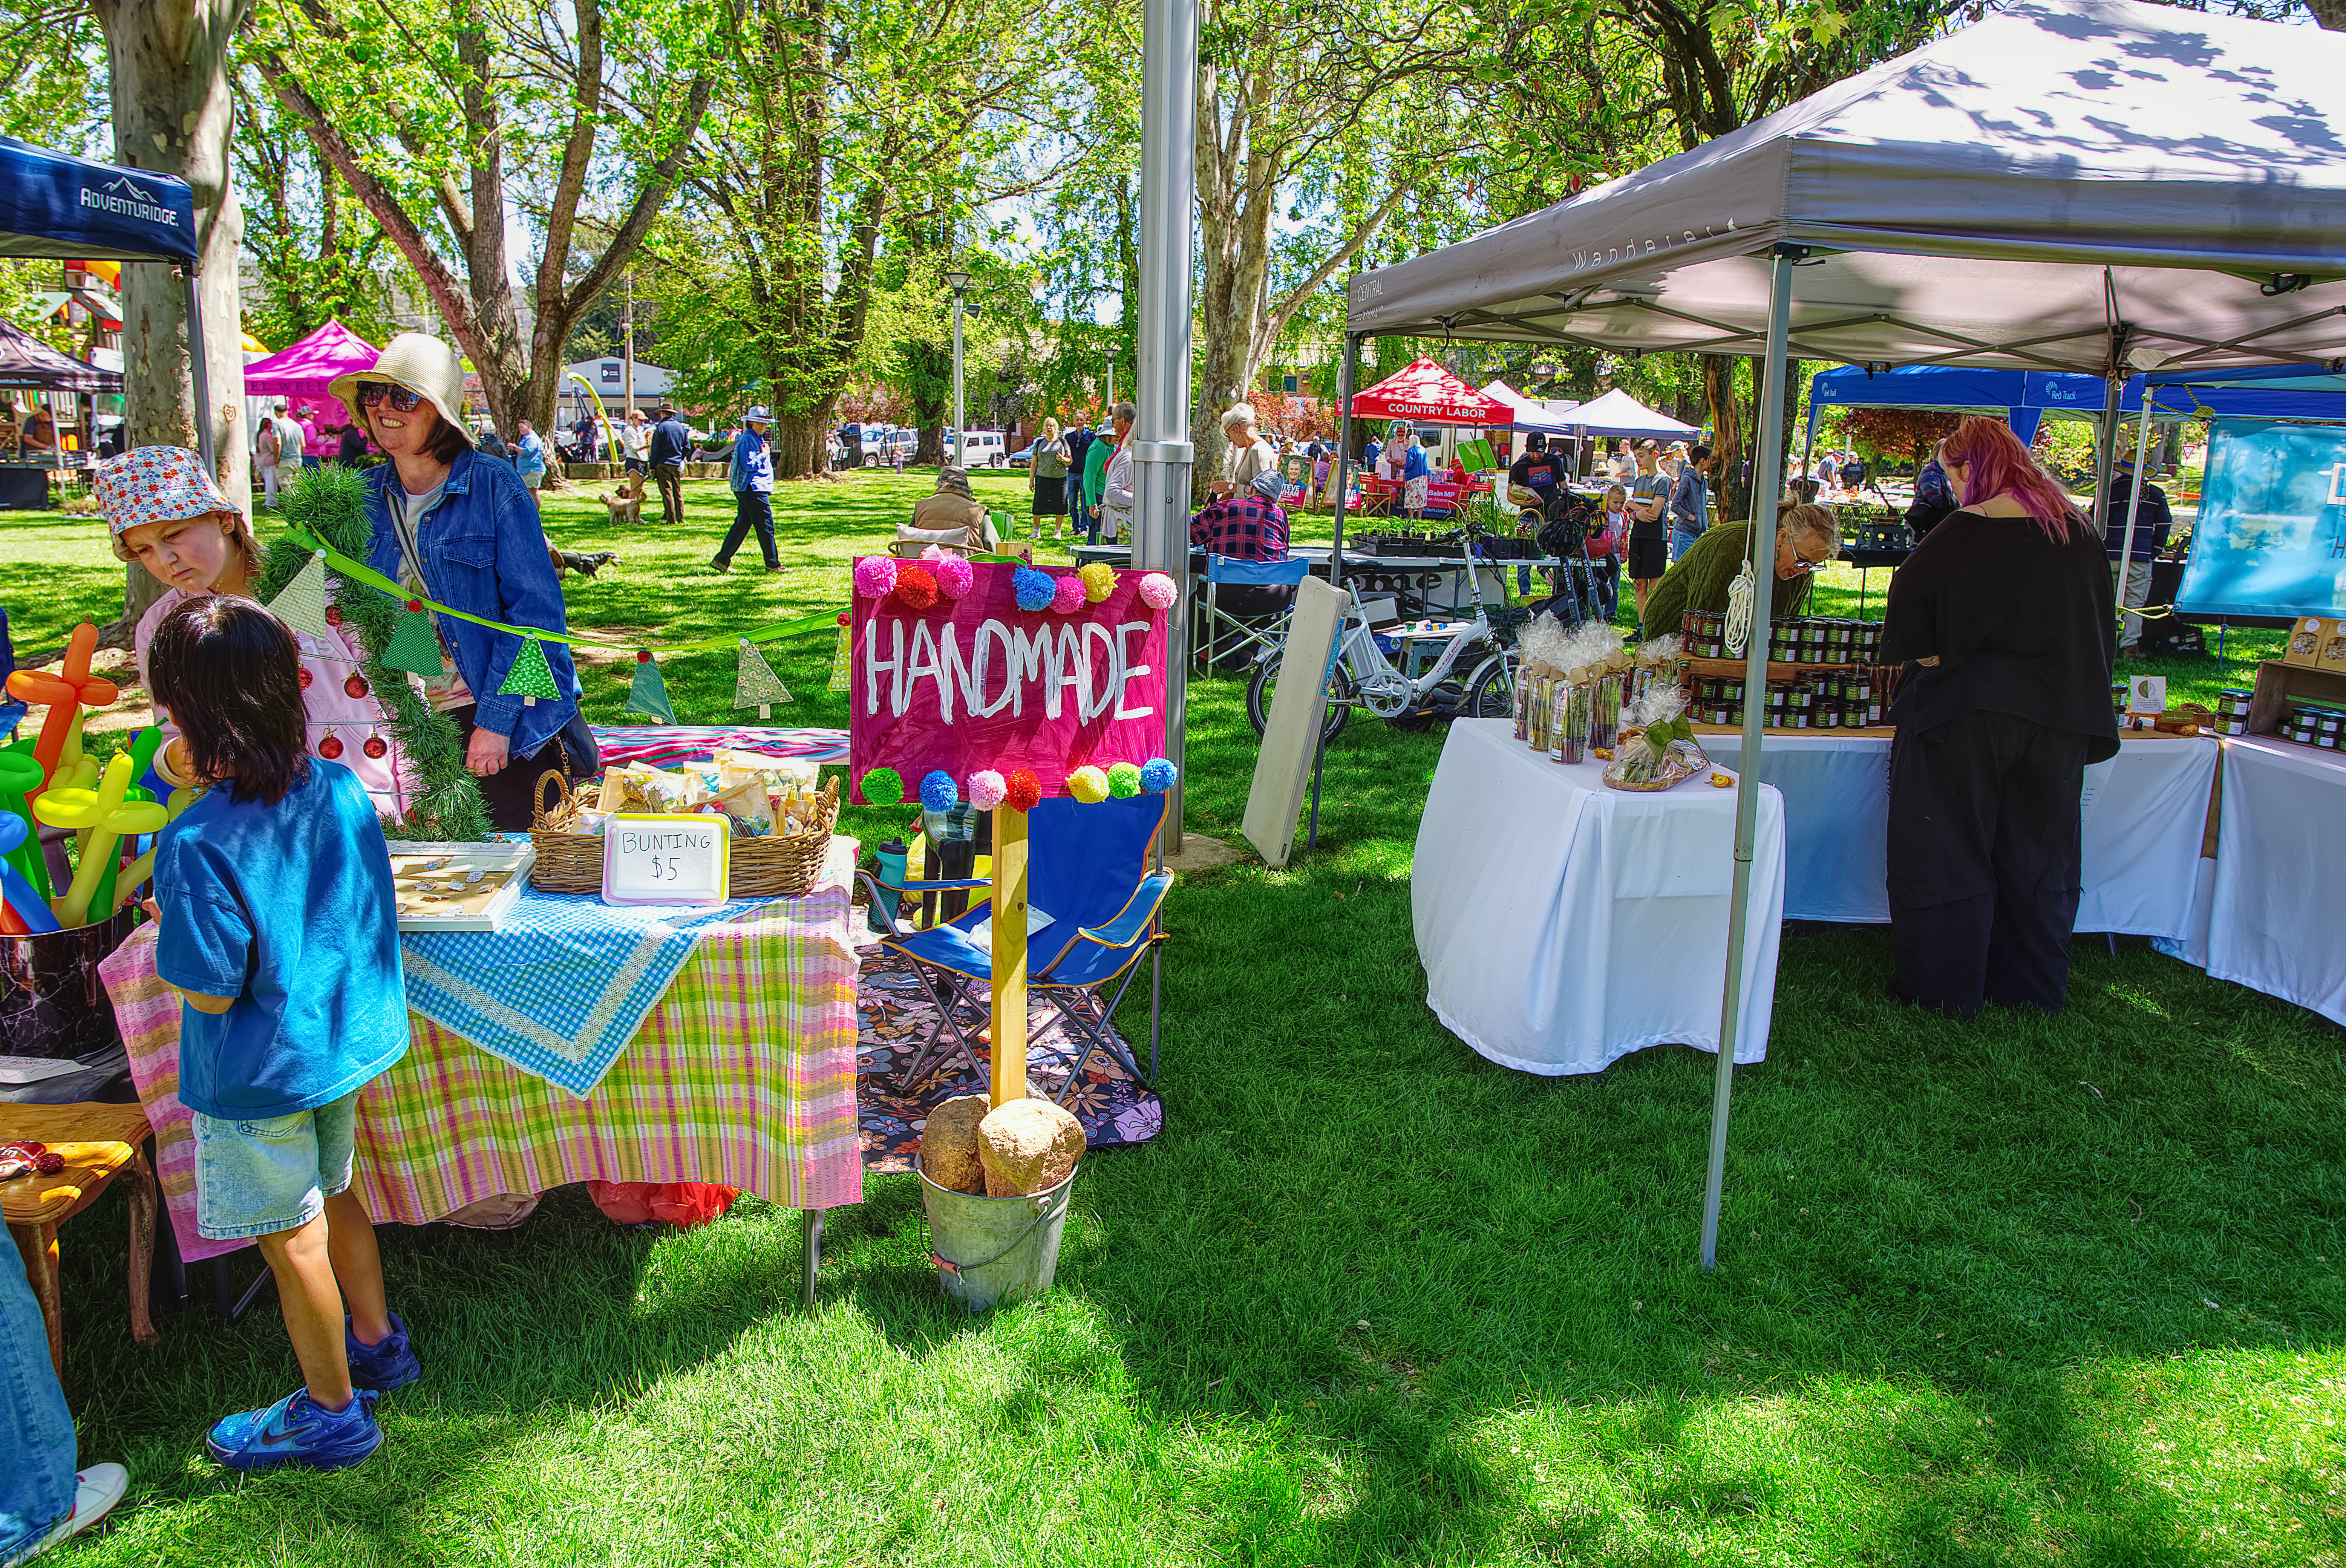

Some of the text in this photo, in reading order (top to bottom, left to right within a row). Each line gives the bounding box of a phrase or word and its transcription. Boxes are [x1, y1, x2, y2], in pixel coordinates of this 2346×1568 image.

[1358, 277, 1383, 303] CENTRAL
[2051, 390, 2077, 400] Red Track
[1388, 403, 1486, 418] COUNTRY LABOR
[1282, 483, 1300, 492] TEVE
[1562, 562, 1572, 591] SEGWAY
[1583, 558, 1593, 586] SEGWAY
[1331, 636, 1340, 663] STANDARD
[1436, 638, 1462, 673] UNI-RYDER FOLDING
[866, 617, 1154, 726] HANDMADE
[622, 832, 711, 853] BUNTING
[651, 854, 680, 880] $5
